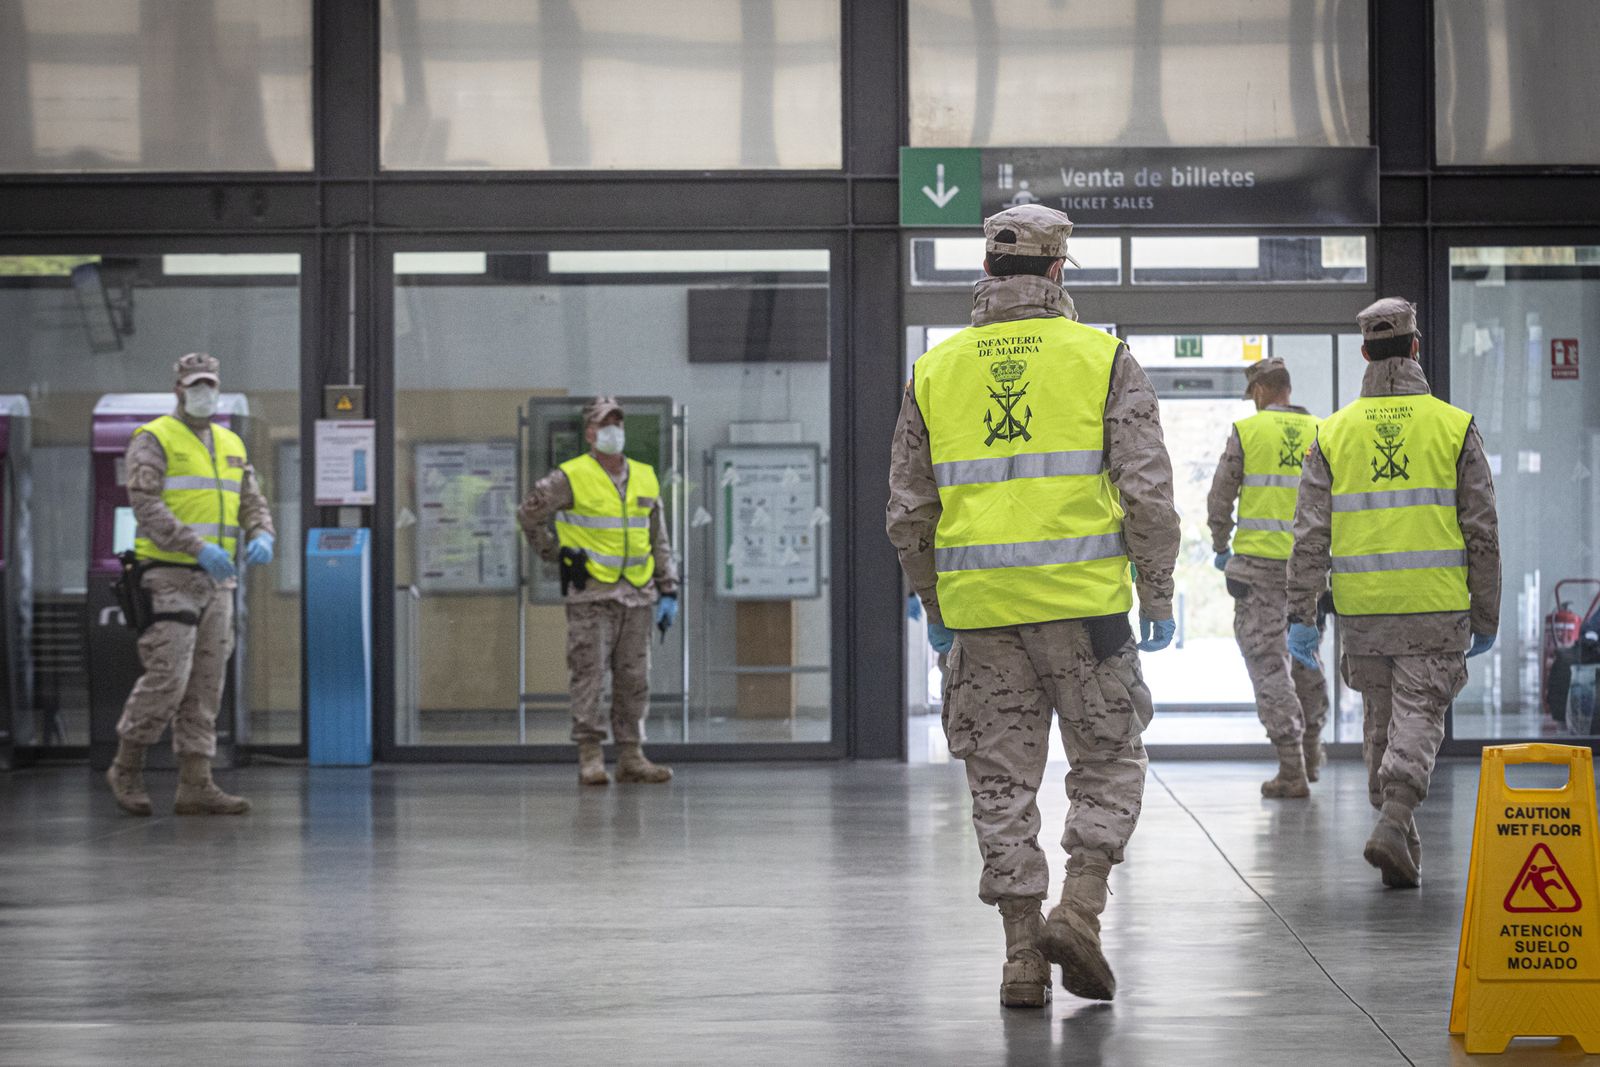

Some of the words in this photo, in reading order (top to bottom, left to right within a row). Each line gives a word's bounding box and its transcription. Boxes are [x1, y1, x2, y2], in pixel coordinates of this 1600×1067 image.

[1060, 167, 1125, 188] Venta
[1134, 167, 1163, 188] de
[1171, 166, 1256, 188] billetes
[1060, 197, 1107, 210] TICKET
[1113, 197, 1154, 210] SALES
[977, 336, 1043, 348] INFANTERIA
[979, 348, 994, 357] DE
[996, 345, 1040, 356] MARINA
[1365, 406, 1414, 415] INFANTERIA
[1366, 413, 1378, 421] DE
[1379, 412, 1413, 421] MARINA
[1504, 806, 1571, 820] CAUTION
[1497, 823, 1529, 836] WET
[1532, 823, 1582, 837] FLOOR
[1515, 940, 1570, 953] SUELO
[1508, 957, 1578, 970] MOJADO
